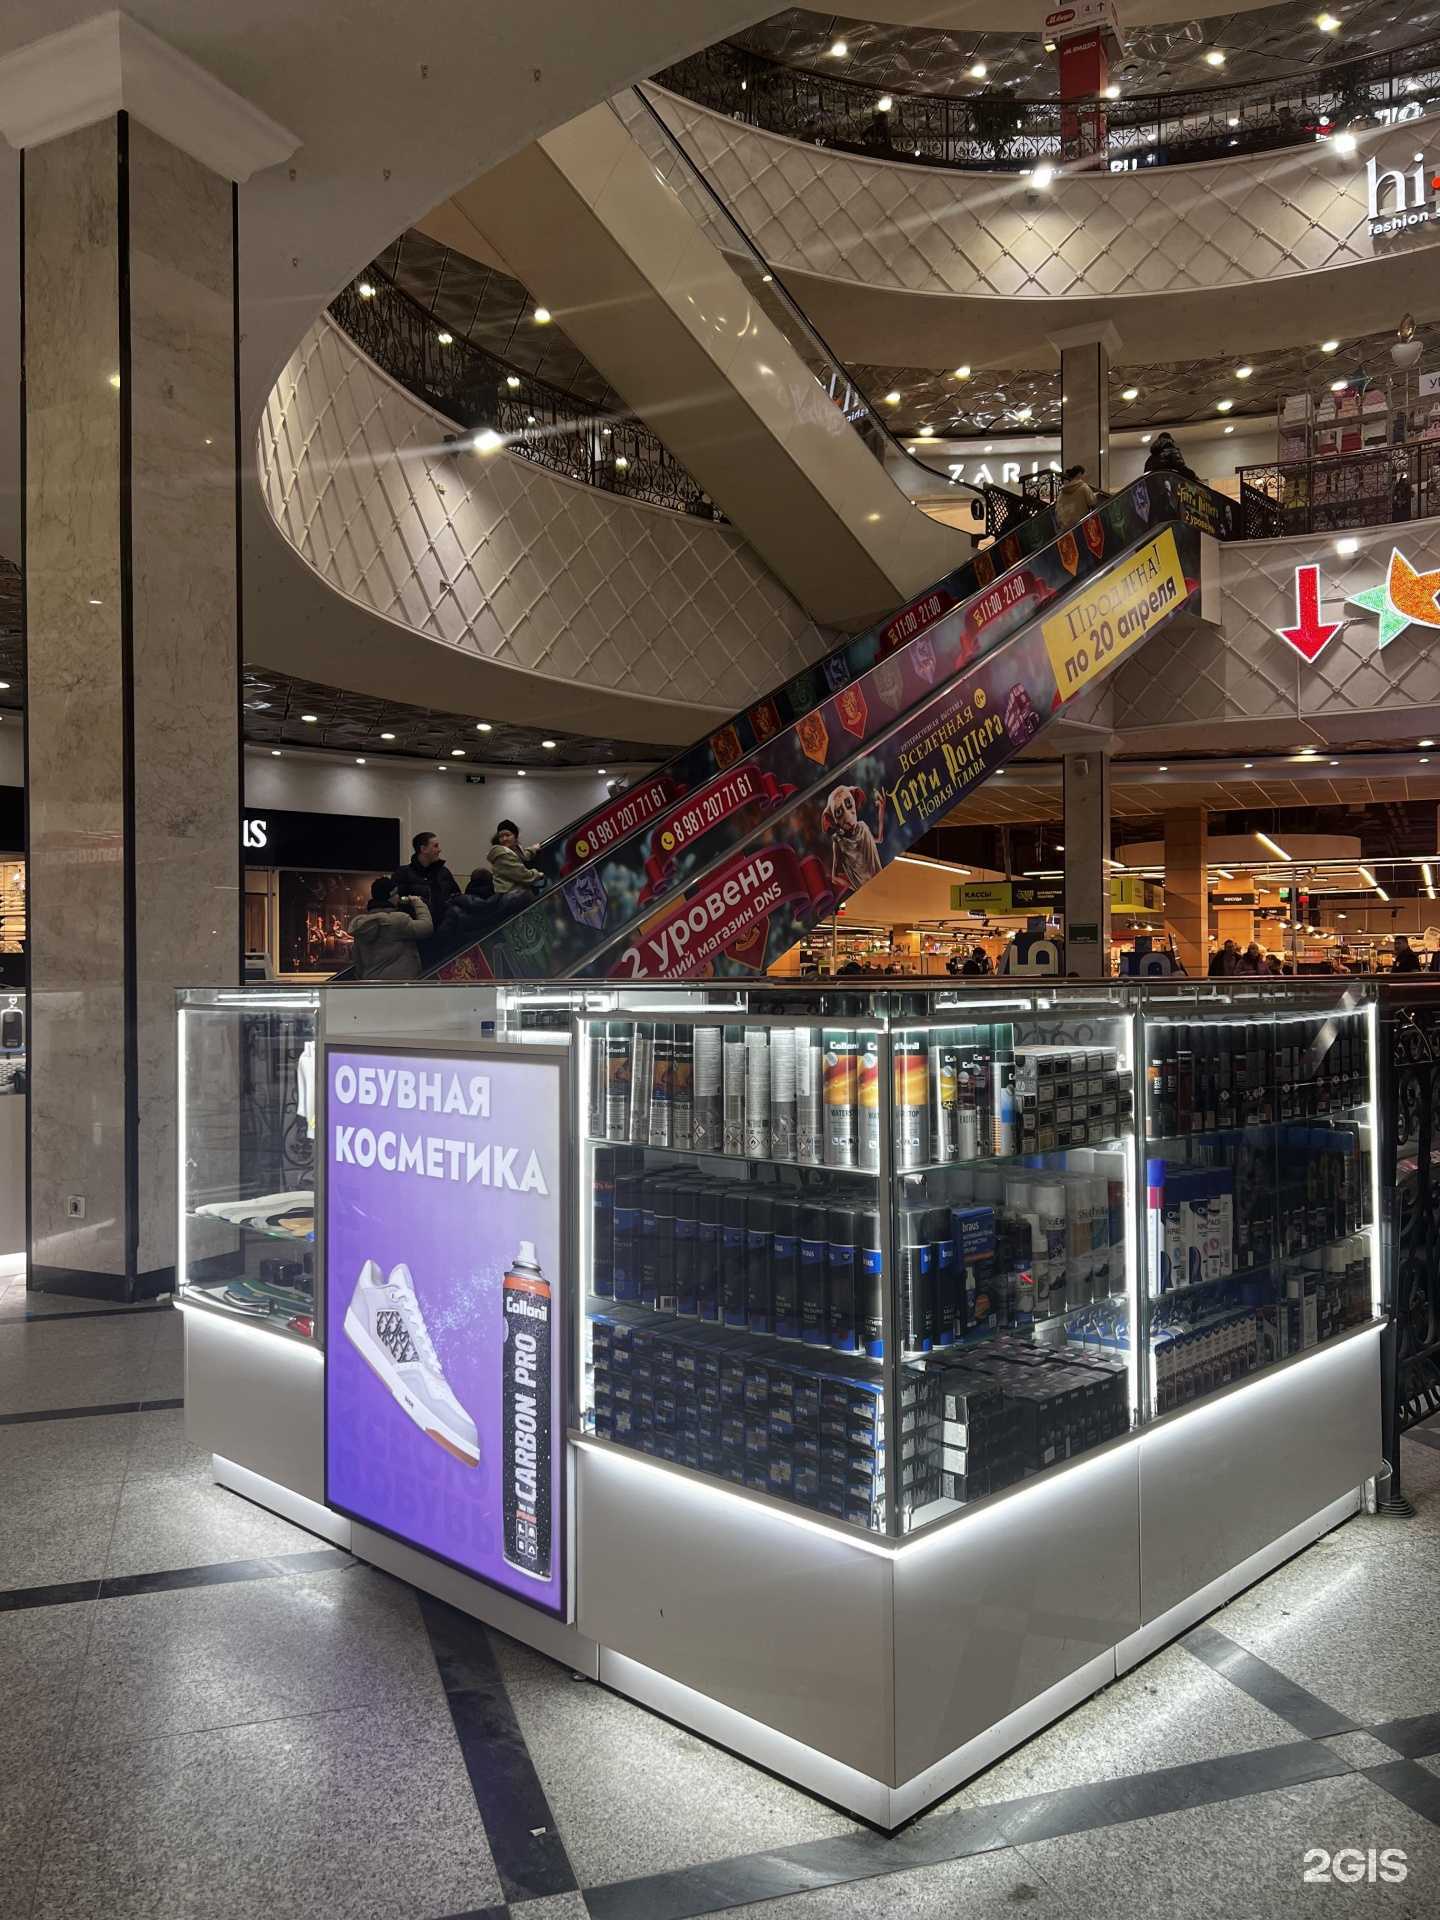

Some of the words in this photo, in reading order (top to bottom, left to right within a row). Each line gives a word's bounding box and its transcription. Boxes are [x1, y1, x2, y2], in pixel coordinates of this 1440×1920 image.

[1368, 211, 1429, 236] fashion
[1065, 649, 1089, 682] по
[1090, 620, 1114, 661] 20
[1117, 576, 1177, 639] апреля
[886, 768, 941, 826] Гарри
[941, 714, 1004, 789] Поттера
[898, 705, 975, 773] ВСЕЛЕННАЯ
[588, 830, 599, 850] 8
[596, 816, 619, 845] 981
[617, 803, 639, 831] 207
[636, 795, 653, 816] 71
[650, 785, 667, 808] 61
[673, 822, 684, 842] 8
[682, 807, 705, 836] 981
[703, 792, 724, 822] 207
[722, 783, 739, 809] 71
[738, 773, 753, 798] 61
[621, 947, 649, 978] 2
[648, 858, 775, 972] уровень
[698, 908, 753, 958] магазин
[755, 881, 782, 912] DNS
[335, 1065, 491, 1118] ОБУВНАЯ
[335, 1125, 549, 1195] КОСМЕТИКА
[506, 1296, 549, 1321] Collonil
[515, 1333, 538, 1388] PRO
[515, 1393, 538, 1504] CARBON
